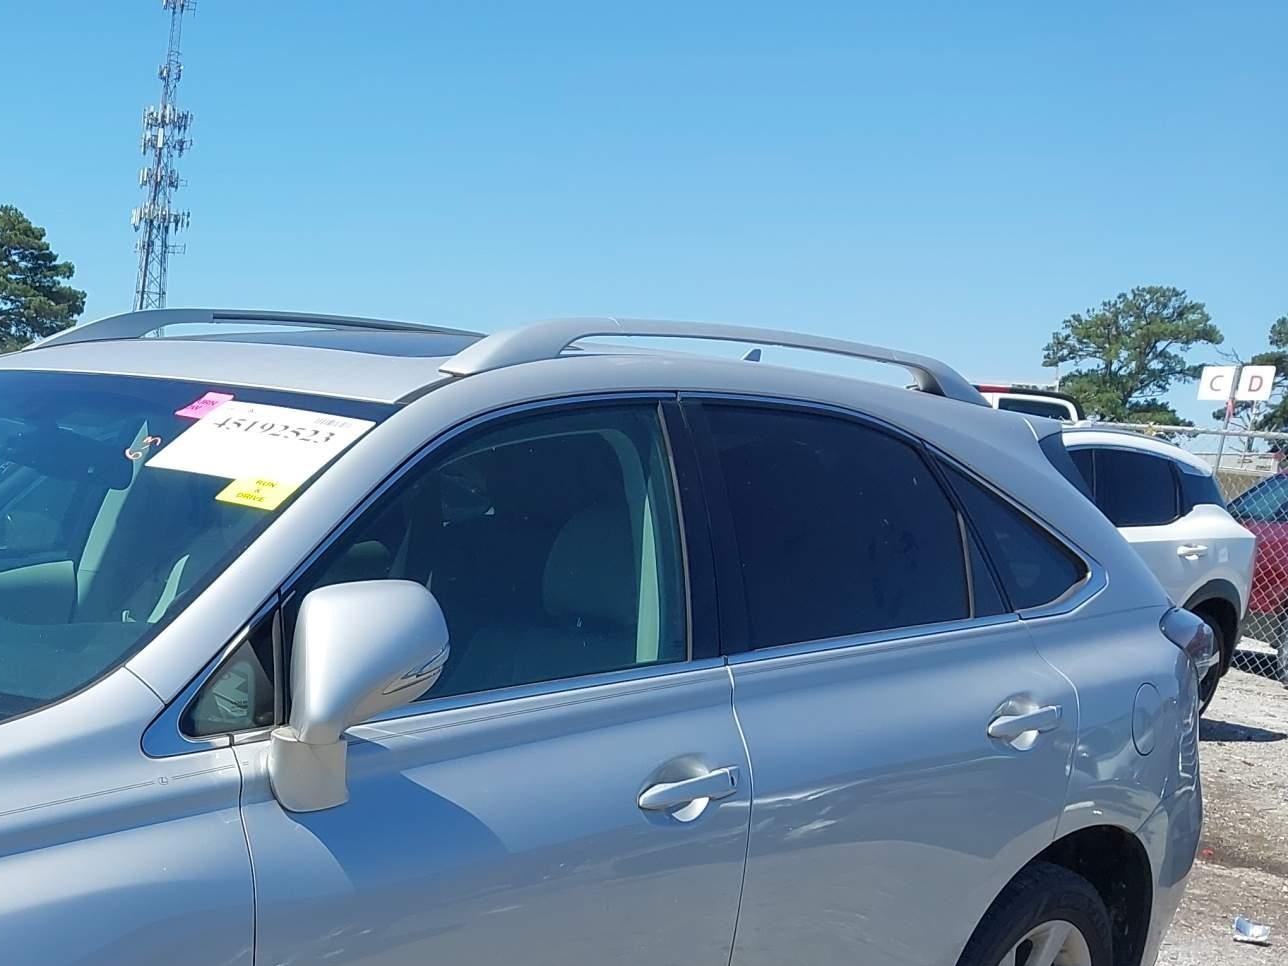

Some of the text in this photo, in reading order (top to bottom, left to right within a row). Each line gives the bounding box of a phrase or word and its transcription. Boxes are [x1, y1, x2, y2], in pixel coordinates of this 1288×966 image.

[1209, 375, 1225, 392] C
[1247, 375, 1264, 392] D
[212, 416, 336, 444] 45192523
[236, 492, 265, 503] DRIVE
